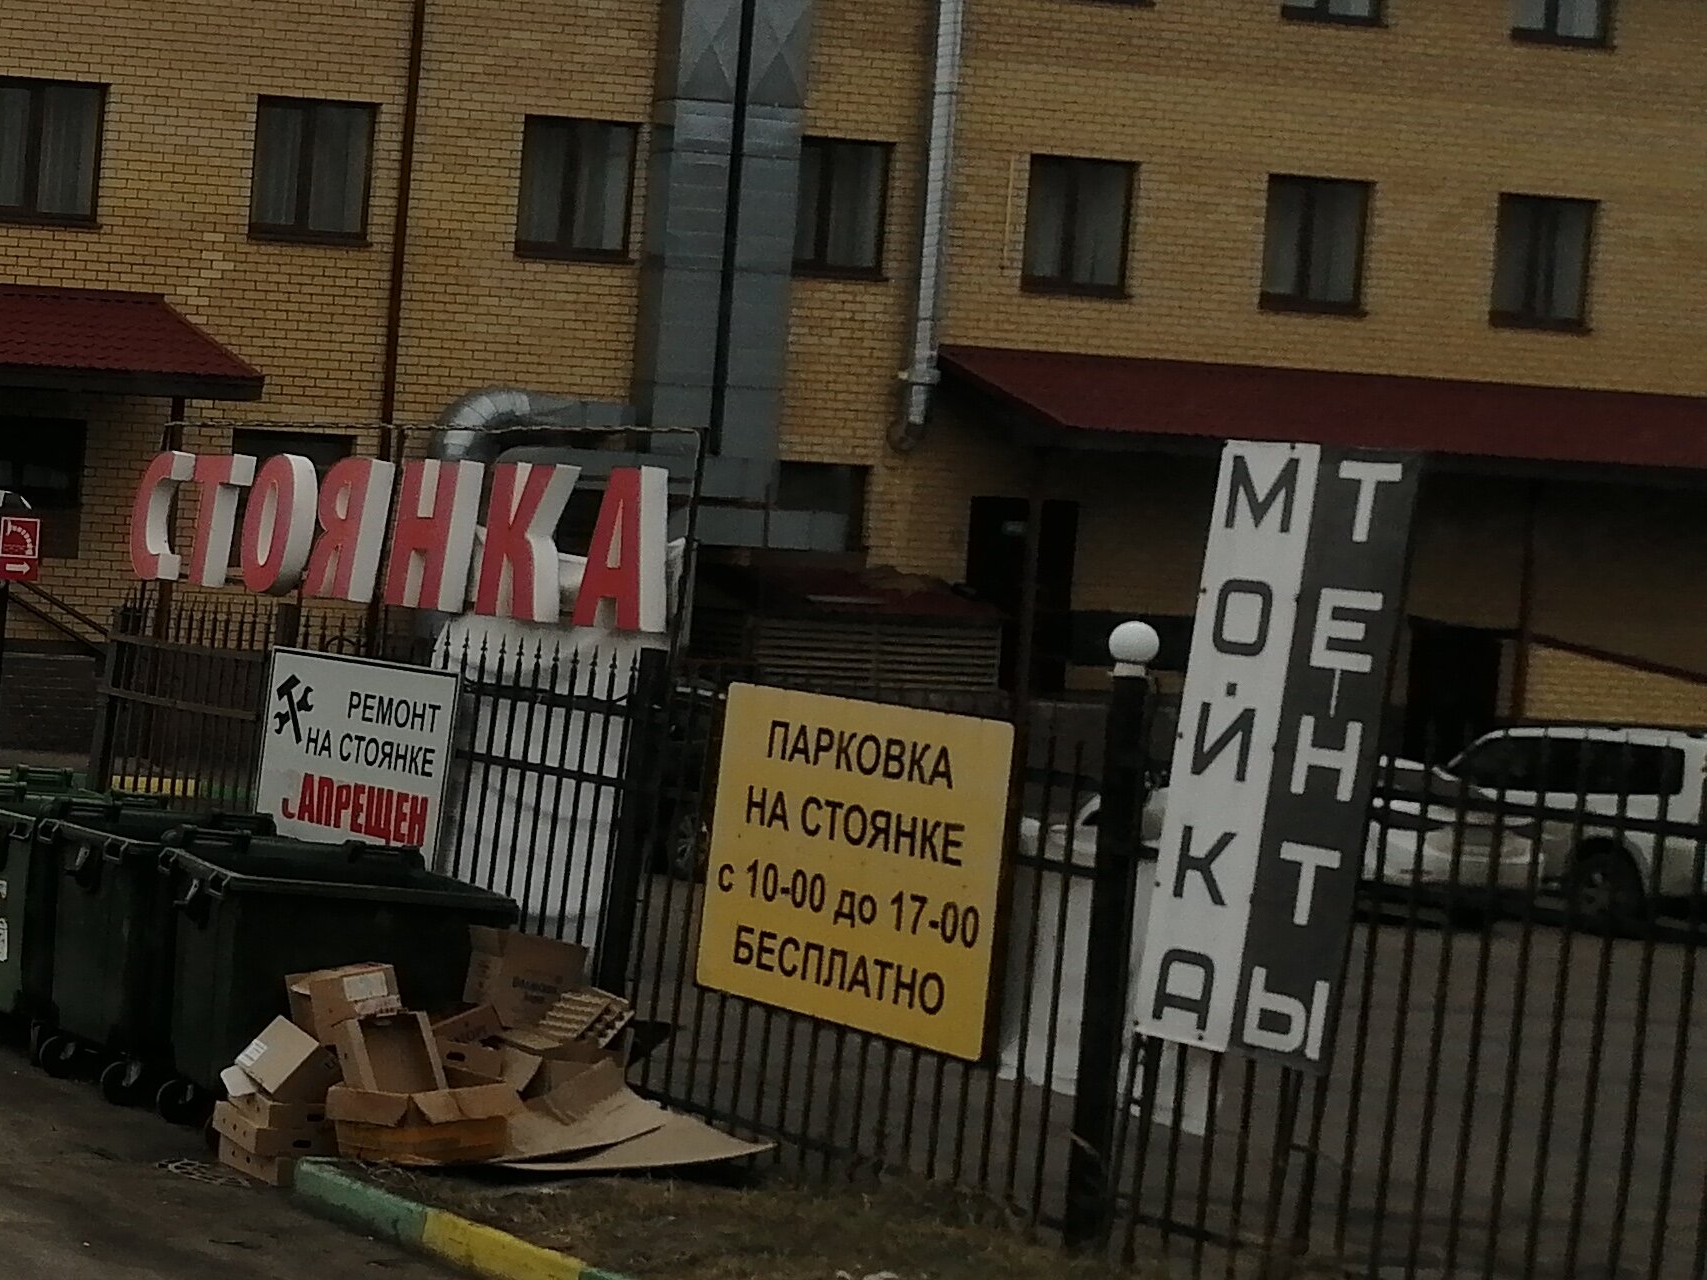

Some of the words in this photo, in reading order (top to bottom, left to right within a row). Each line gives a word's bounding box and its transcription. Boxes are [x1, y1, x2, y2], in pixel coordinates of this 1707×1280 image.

[129, 450, 670, 632] СТОЯНКА
[305, 726, 332, 758] НА
[339, 732, 435, 777] СТОЯНКЕ
[348, 691, 442, 732] РЕМОНТ
[767, 719, 954, 790] ПАРКОВКА
[1150, 455, 1300, 1031] МОЙКА
[1242, 460, 1403, 1061] ТЕНТЫ
[746, 785, 789, 832] НА
[801, 796, 965, 867] СТОЯНКЕ
[718, 863, 735, 892] с
[747, 858, 826, 913] 10-00
[832, 889, 878, 929] до
[890, 890, 979, 949] 17-00
[733, 924, 945, 1016] БЕСПЛАТНО
